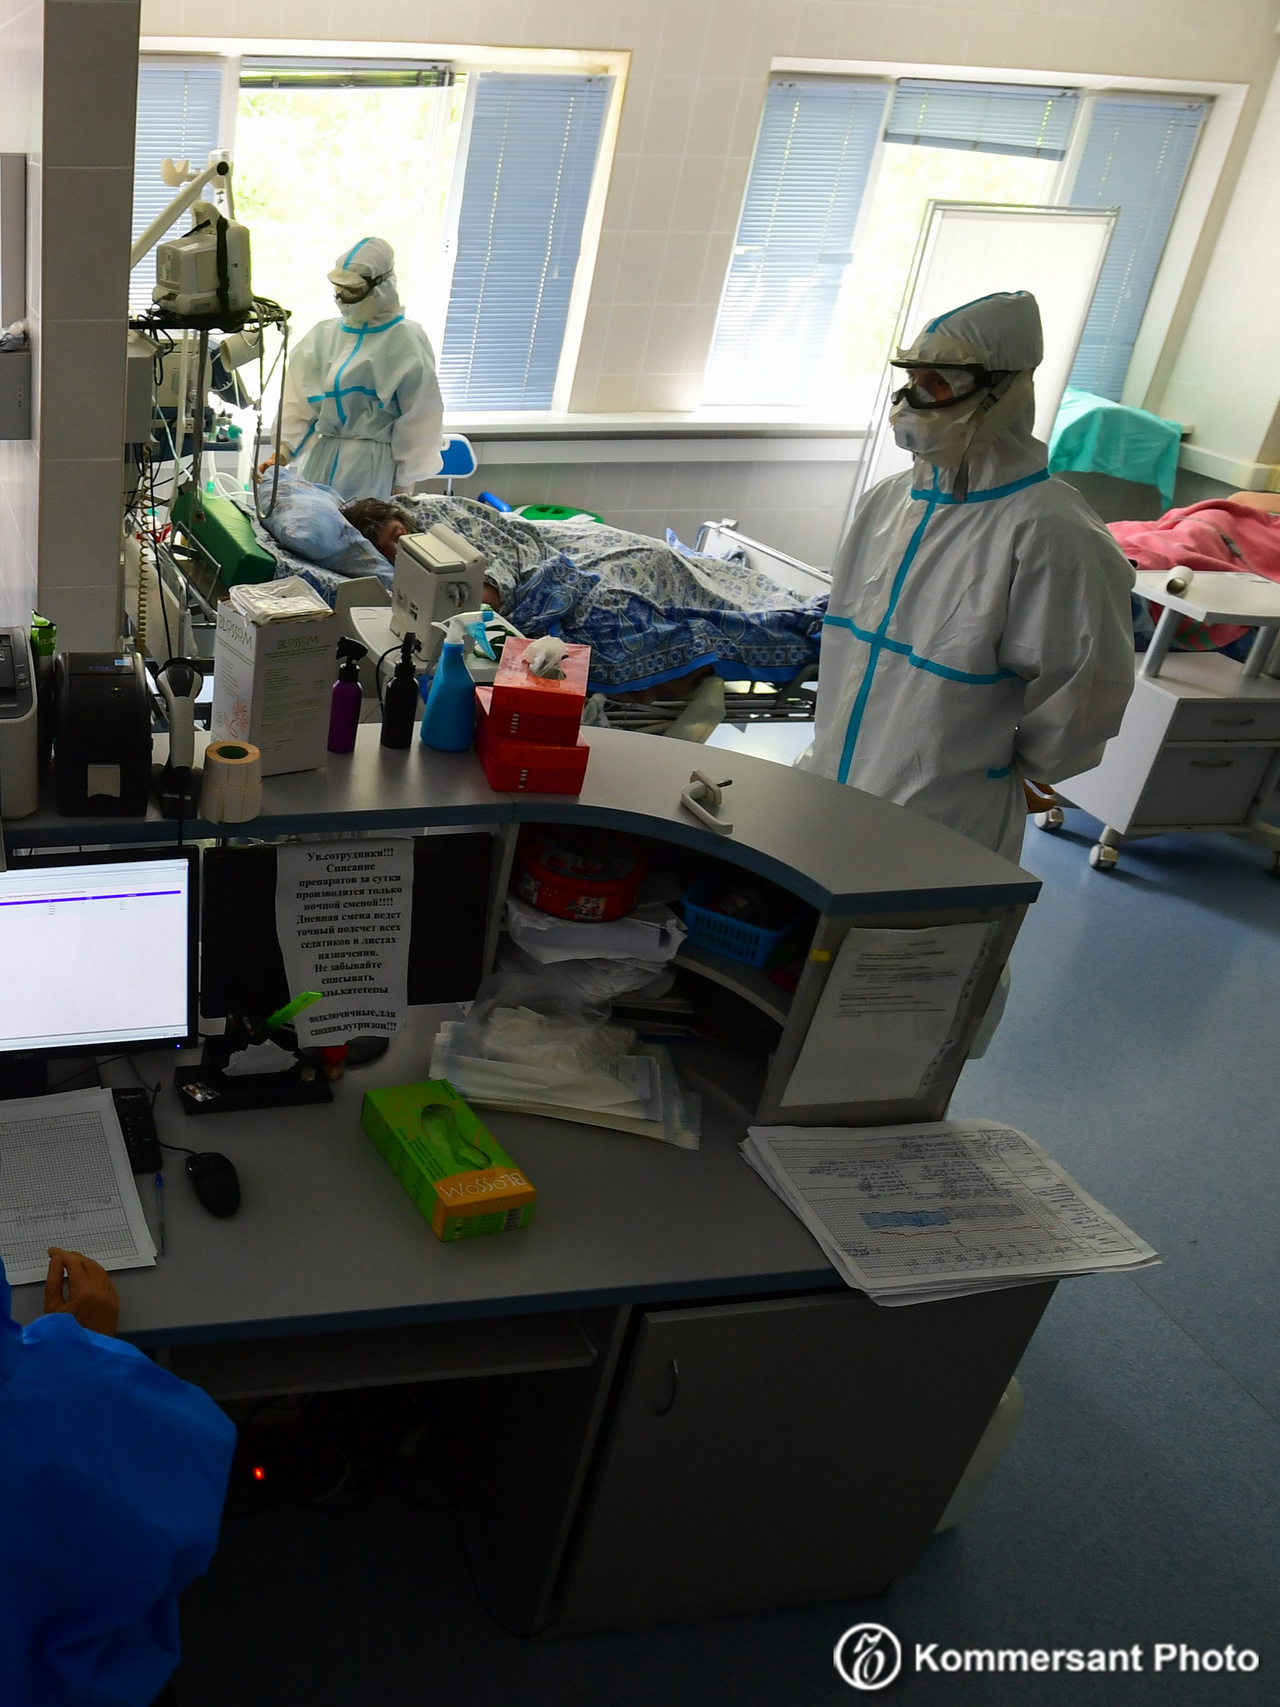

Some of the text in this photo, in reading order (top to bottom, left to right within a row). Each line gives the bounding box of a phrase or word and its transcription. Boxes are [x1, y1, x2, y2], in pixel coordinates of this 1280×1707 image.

[218, 614, 253, 650] BLOSSOM
[278, 635, 319, 649] BLOSSOM
[307, 848, 393, 862] Ув.сотрудники!!!
[326, 863, 375, 872] Списание
[299, 877, 357, 888] препаратов
[372, 875, 401, 884] сутки
[296, 889, 364, 900] производится
[304, 898, 393, 910] ночной сменой!!!!
[296, 914, 339, 924] Дневная
[374, 912, 401, 920] ведет
[297, 927, 334, 936] точный
[337, 926, 377, 934] подсчет
[301, 939, 350, 948] седатиков
[318, 951, 378, 960] назначения.
[314, 962, 382, 973] Не забывайте
[321, 975, 374, 984] списывать
